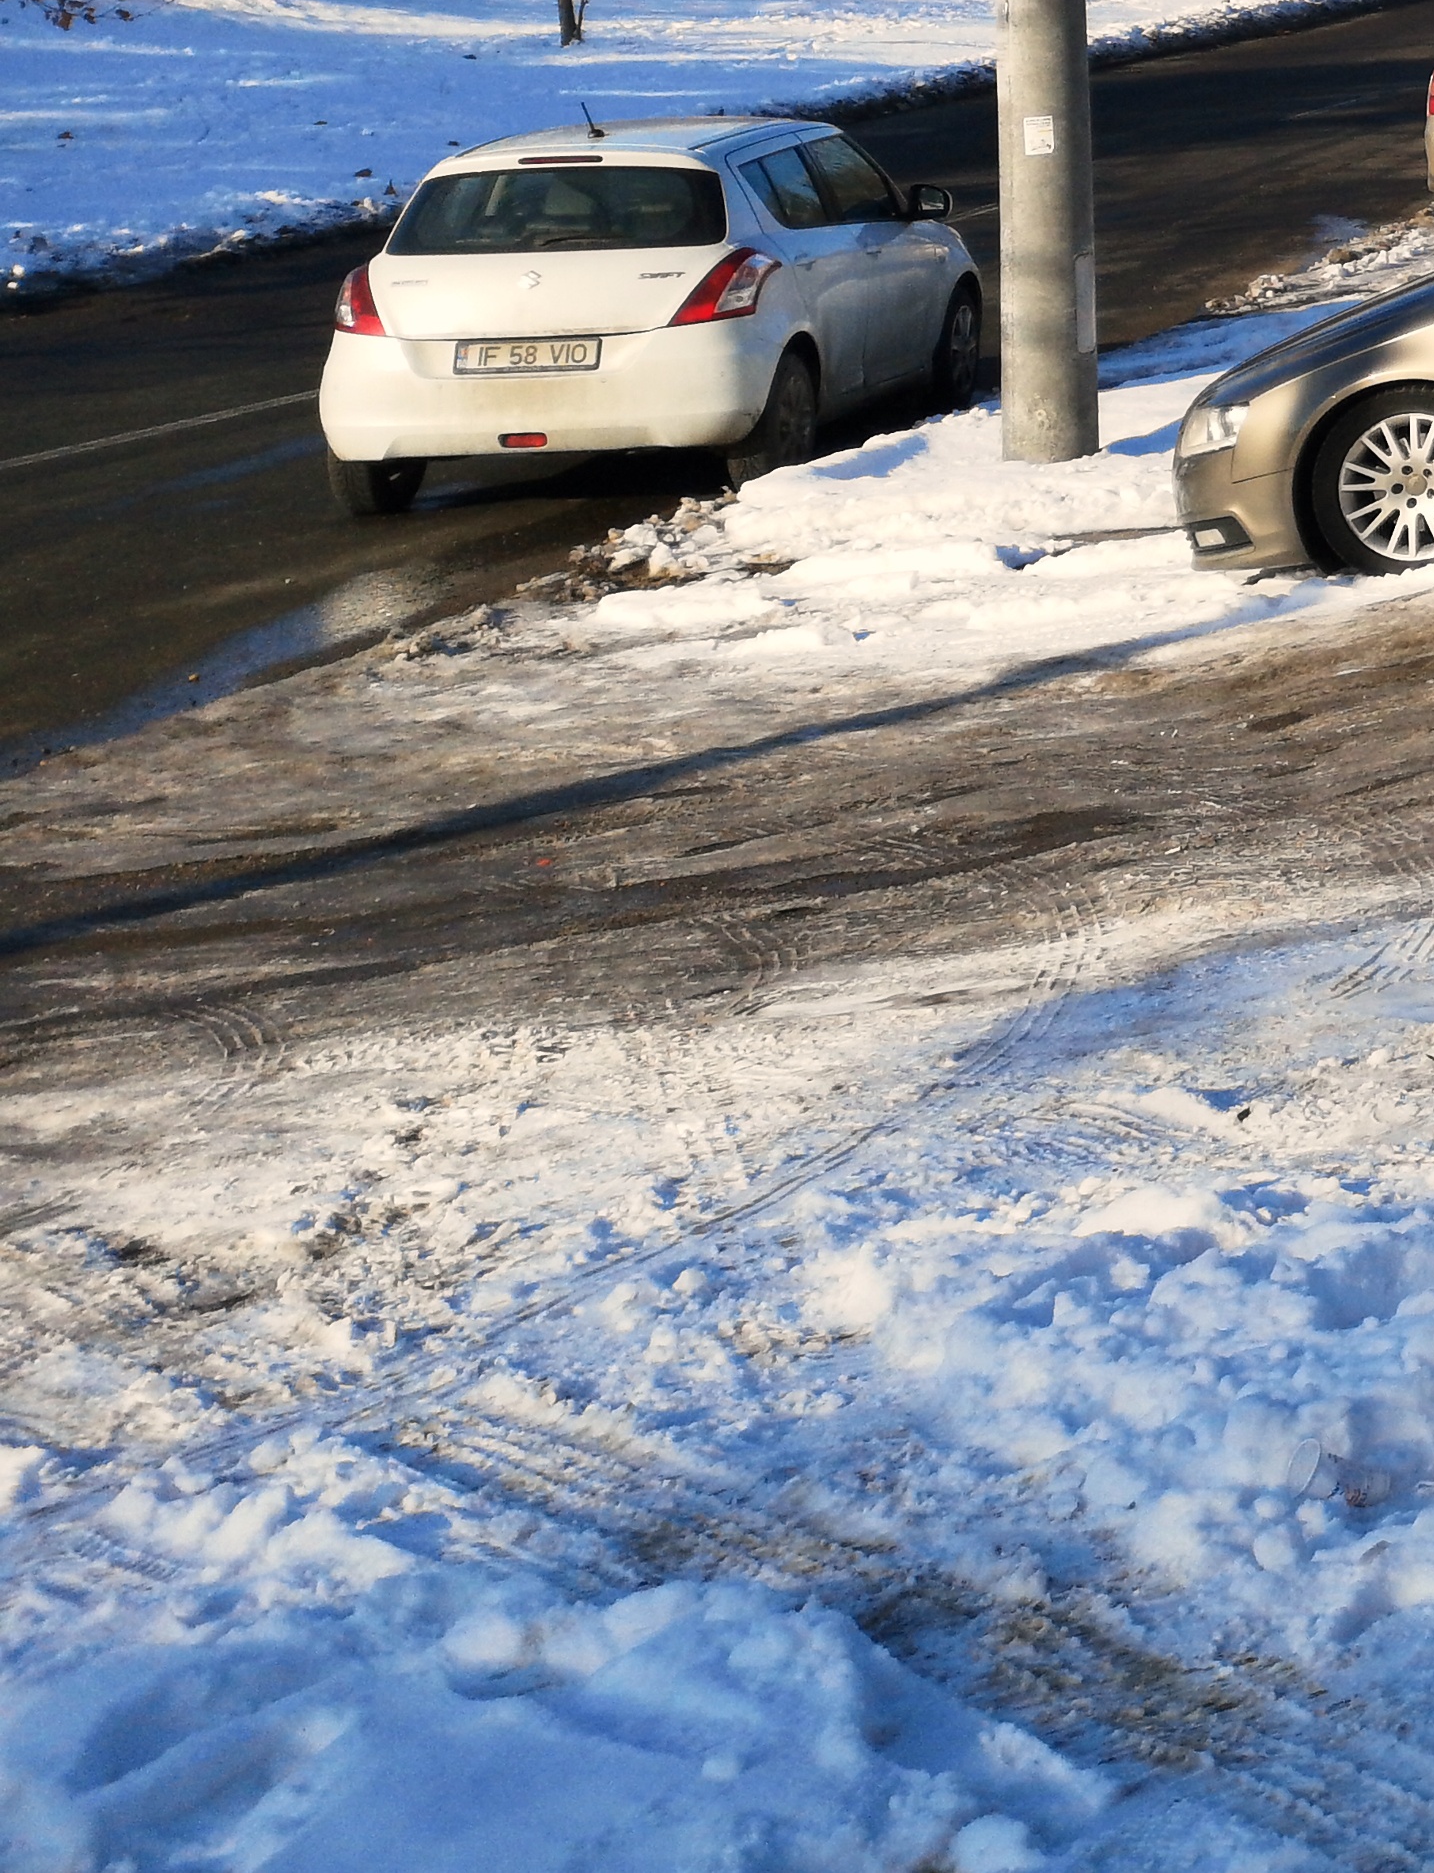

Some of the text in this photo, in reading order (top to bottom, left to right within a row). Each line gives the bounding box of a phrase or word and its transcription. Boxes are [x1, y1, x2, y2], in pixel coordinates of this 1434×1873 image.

[477, 343, 588, 367] IF 58 VIO
